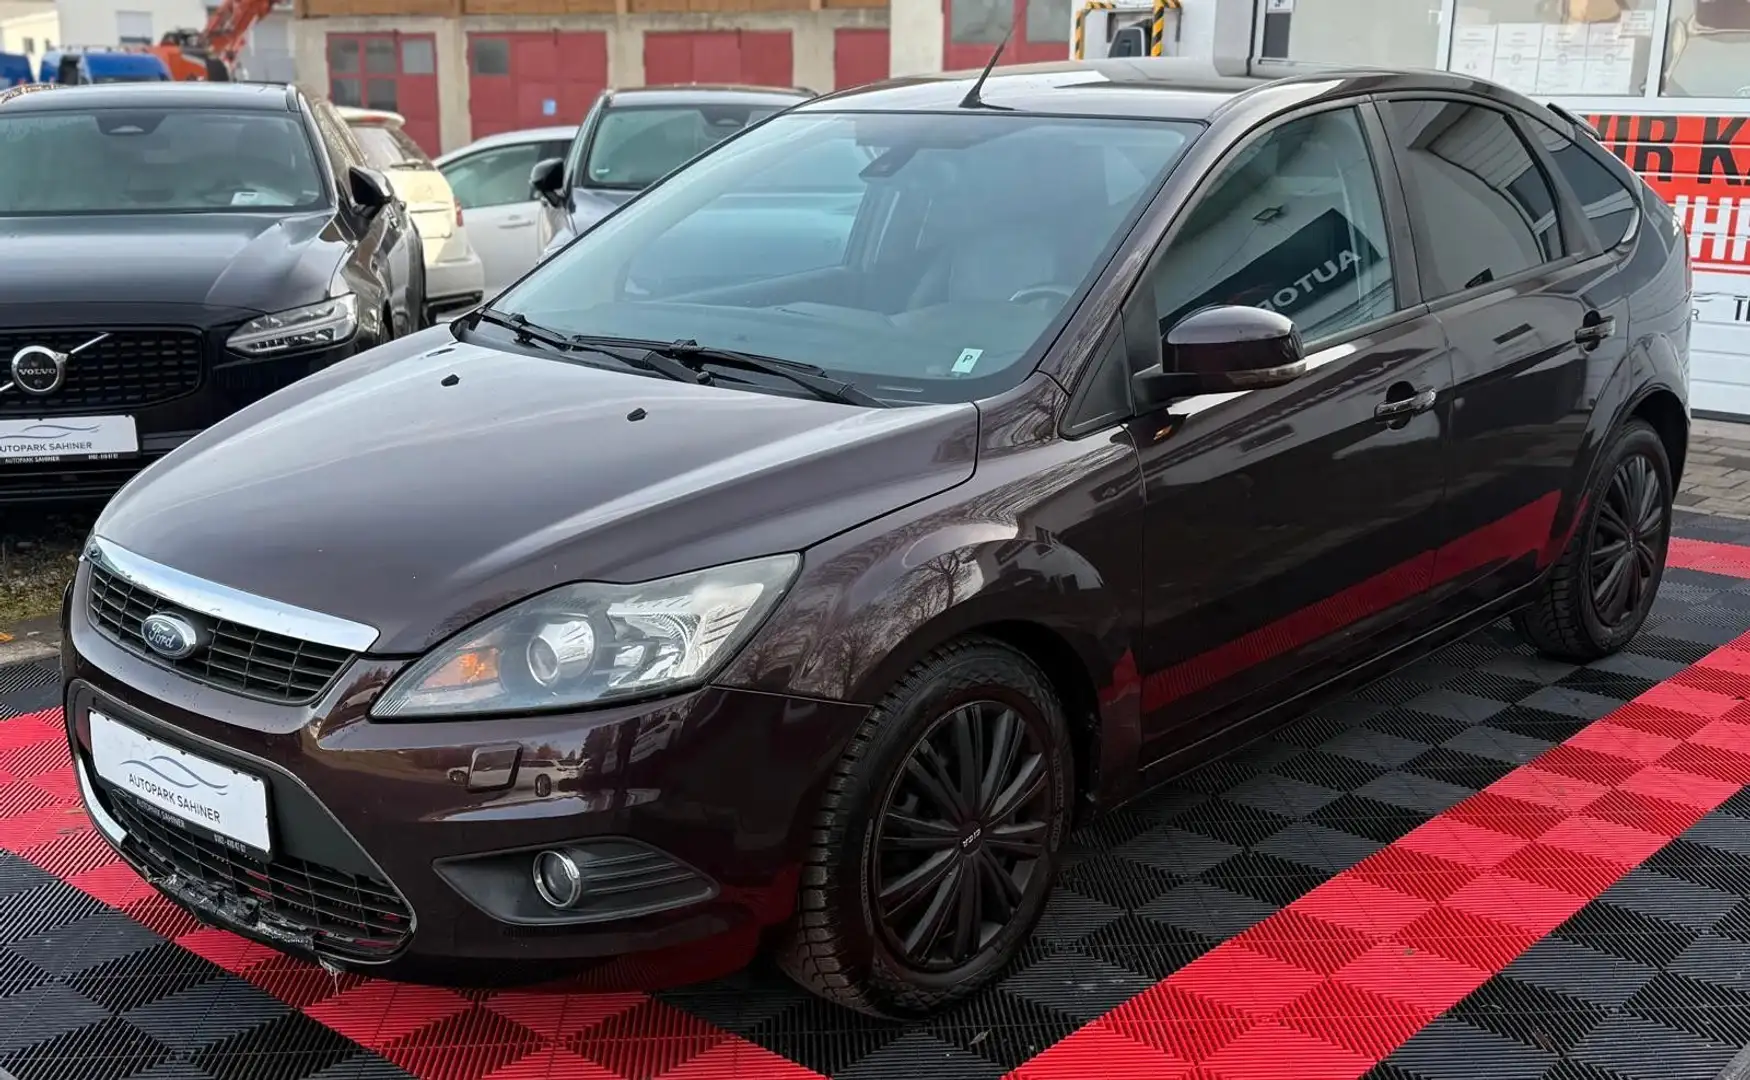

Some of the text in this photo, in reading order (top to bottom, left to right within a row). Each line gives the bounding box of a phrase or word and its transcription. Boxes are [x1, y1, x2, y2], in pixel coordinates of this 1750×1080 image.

[1580, 115, 1750, 185] IR K
[1733, 295, 1750, 321] T
[963, 354, 974, 363] P
[19, 368, 56, 376] VOLVO
[0, 441, 92, 452] UTOPARK SAHINER
[149, 622, 176, 648] Ford
[129, 773, 221, 824] AUTOPARK SAHINER
